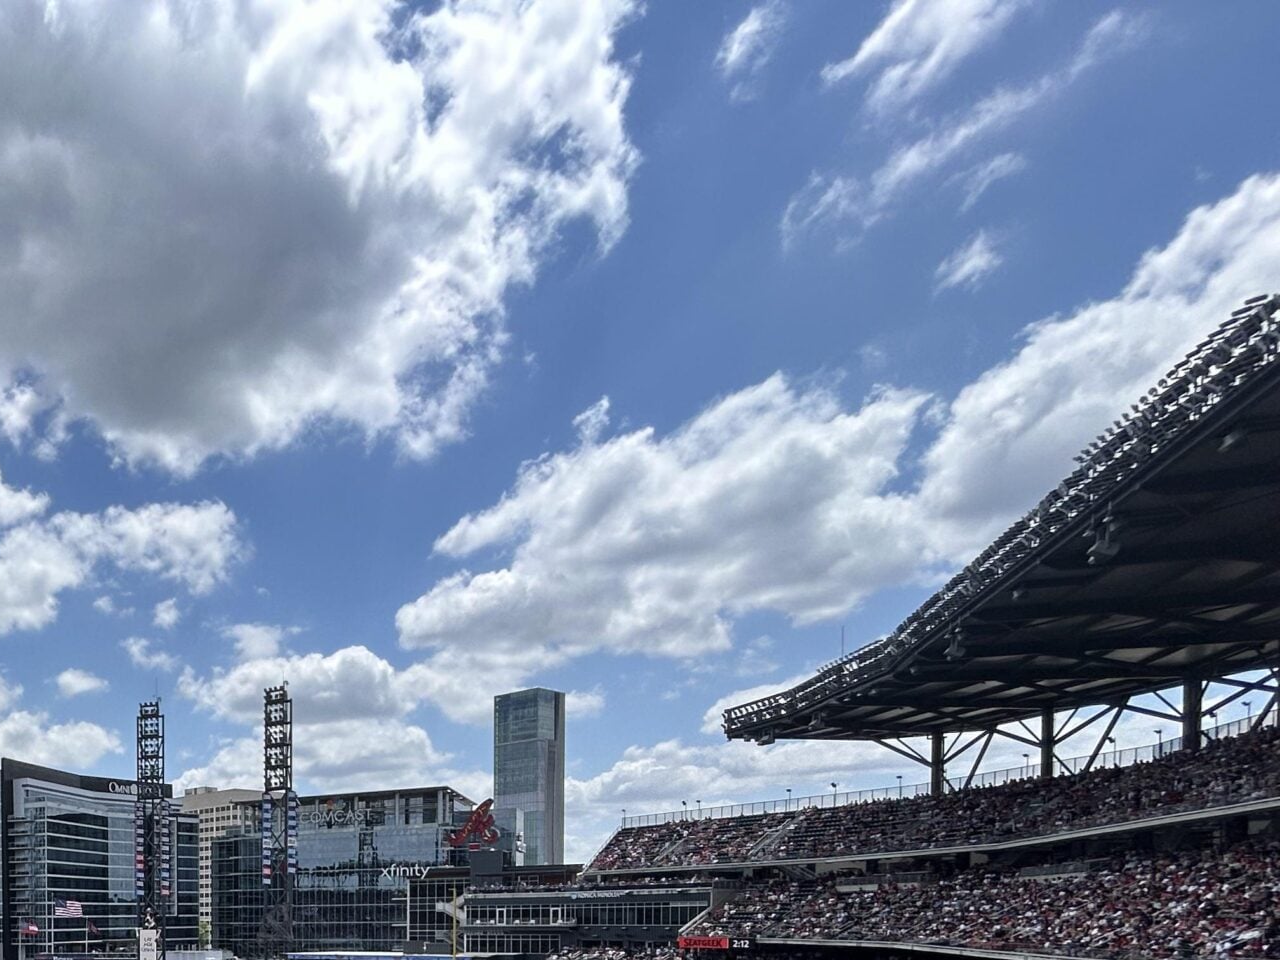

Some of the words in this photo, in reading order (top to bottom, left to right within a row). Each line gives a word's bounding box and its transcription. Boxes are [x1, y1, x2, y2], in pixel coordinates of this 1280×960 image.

[299, 808, 371, 825] COMCAST
[380, 863, 431, 881] xfinity
[732, 939, 750, 949] 2:12
